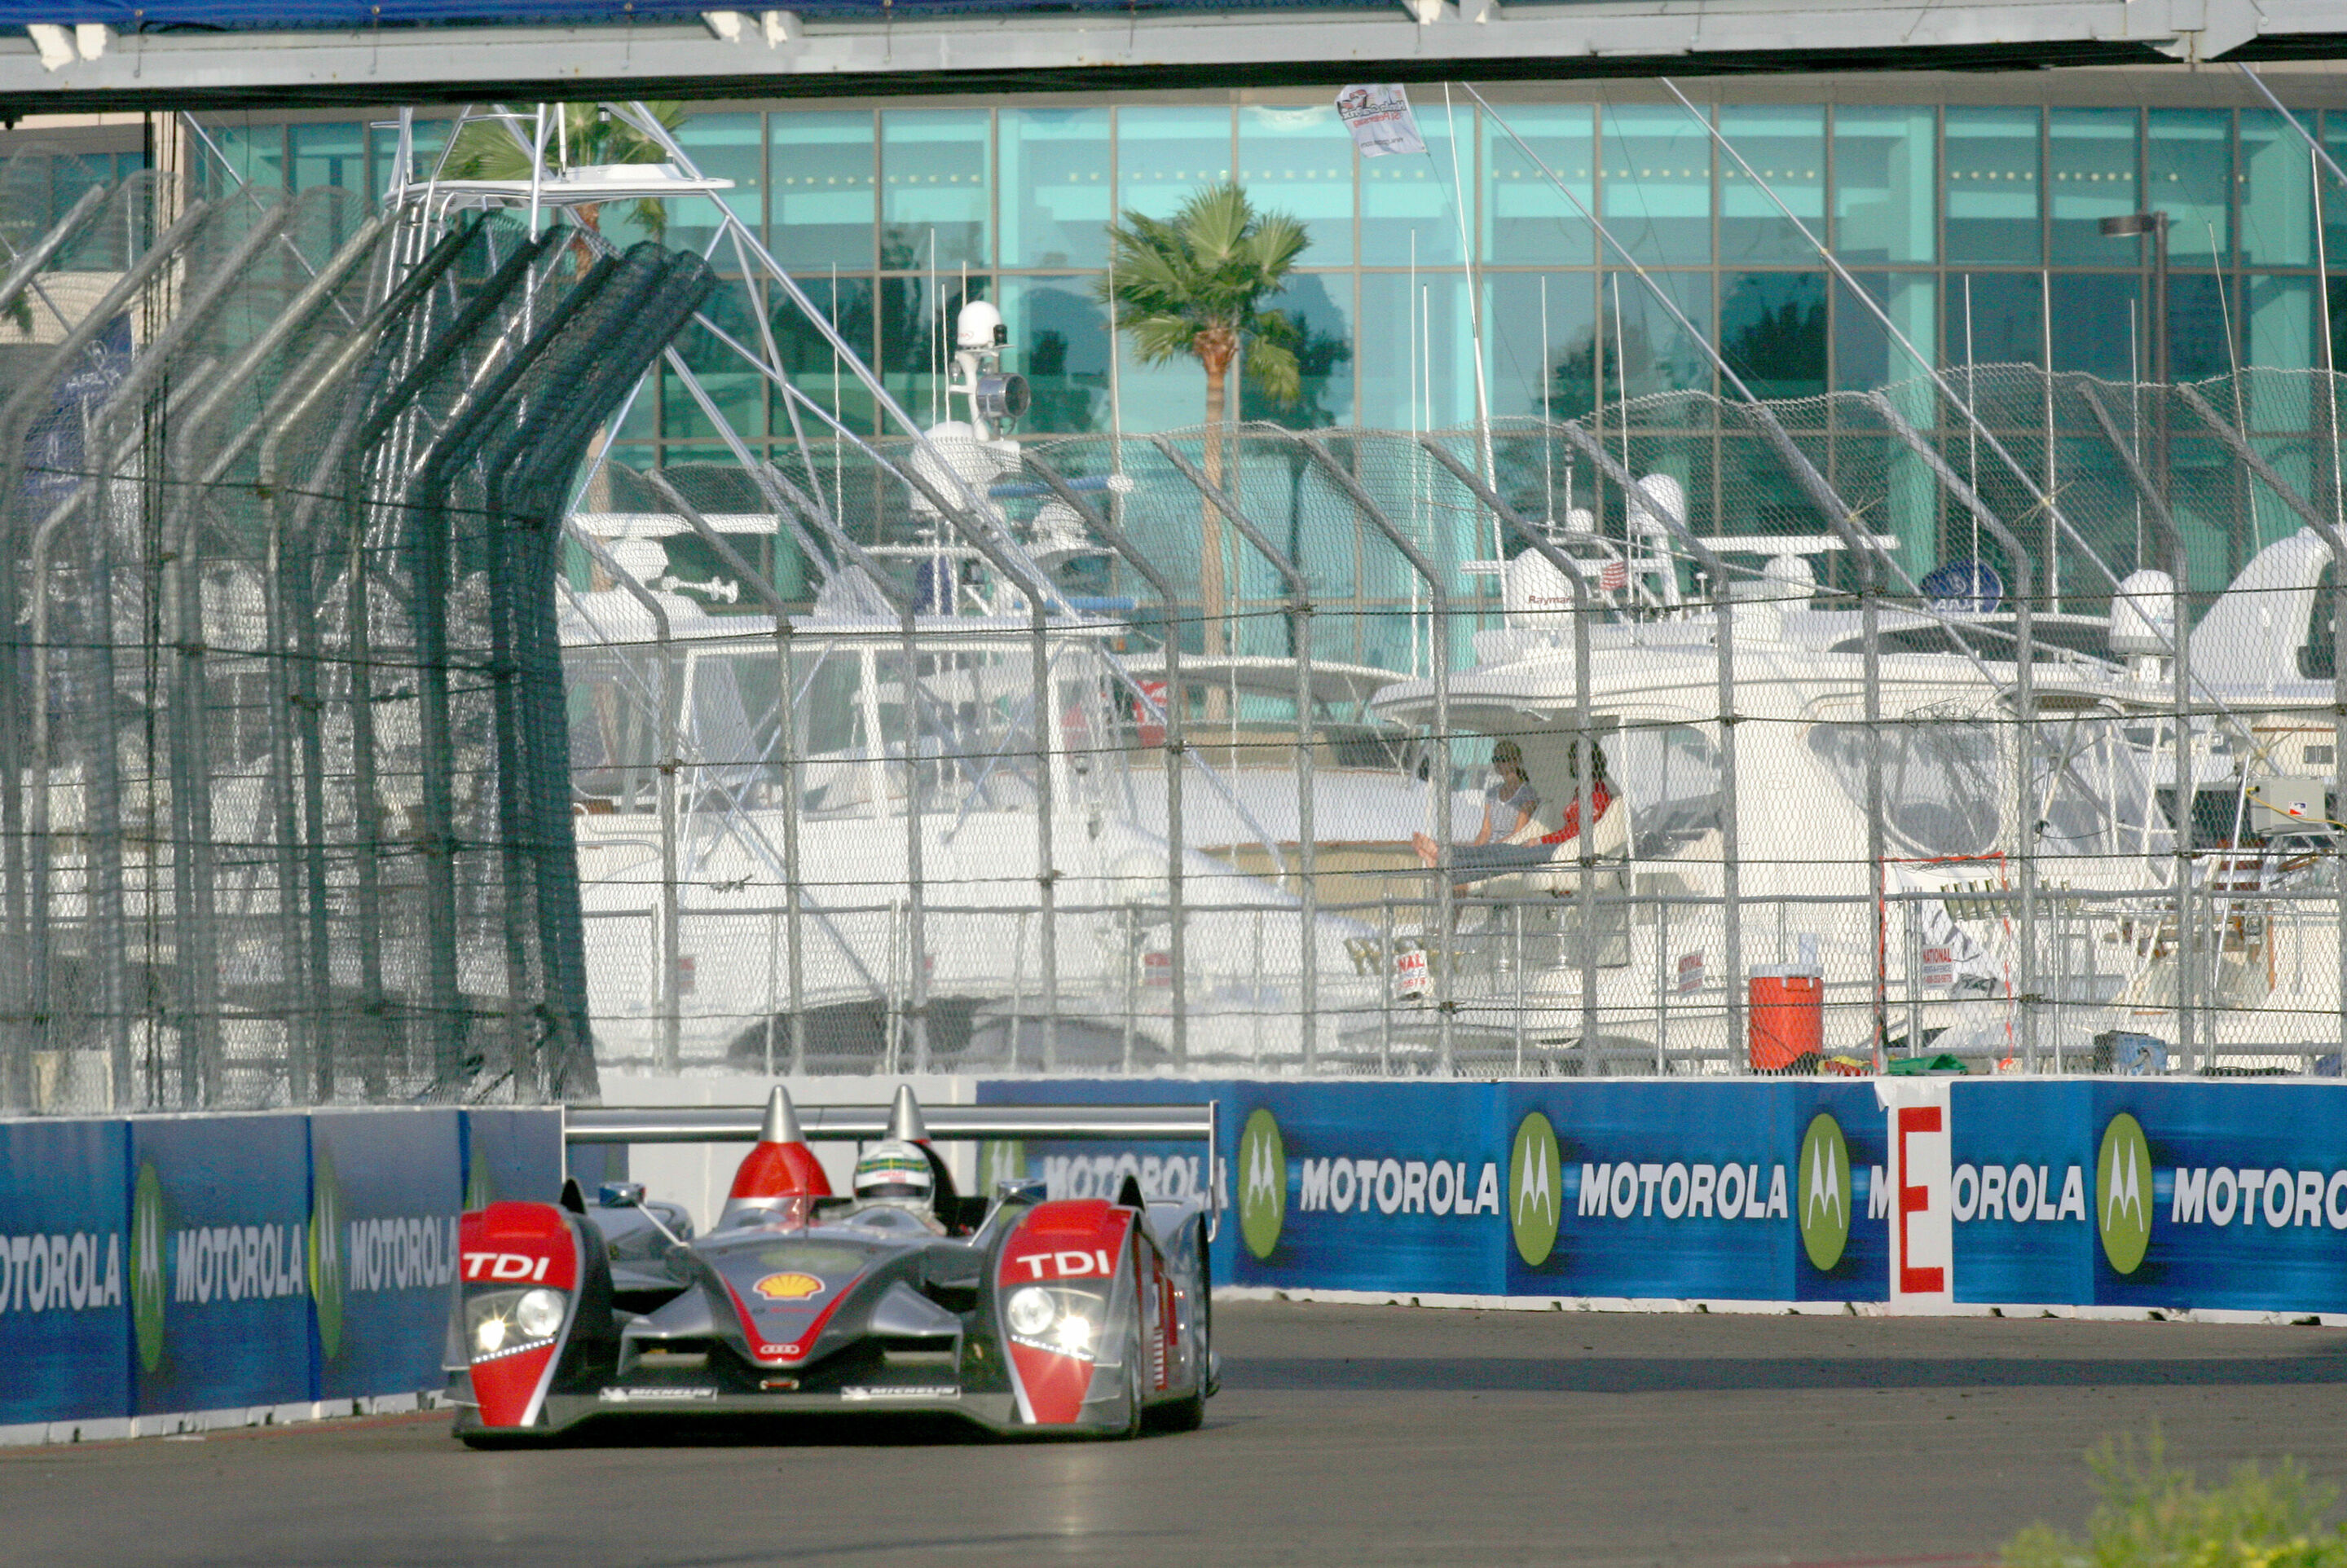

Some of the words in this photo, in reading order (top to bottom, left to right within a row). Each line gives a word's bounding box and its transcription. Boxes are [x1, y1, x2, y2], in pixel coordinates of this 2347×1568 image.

[1301, 1158, 1499, 1215] MOTOROLA
[1579, 1162, 1788, 1219] MOTOROLA
[1898, 1107, 1944, 1293] E
[176, 1223, 304, 1303] MOTOROLA
[463, 1253, 550, 1281] TDI
[1017, 1250, 1111, 1279] TDI
